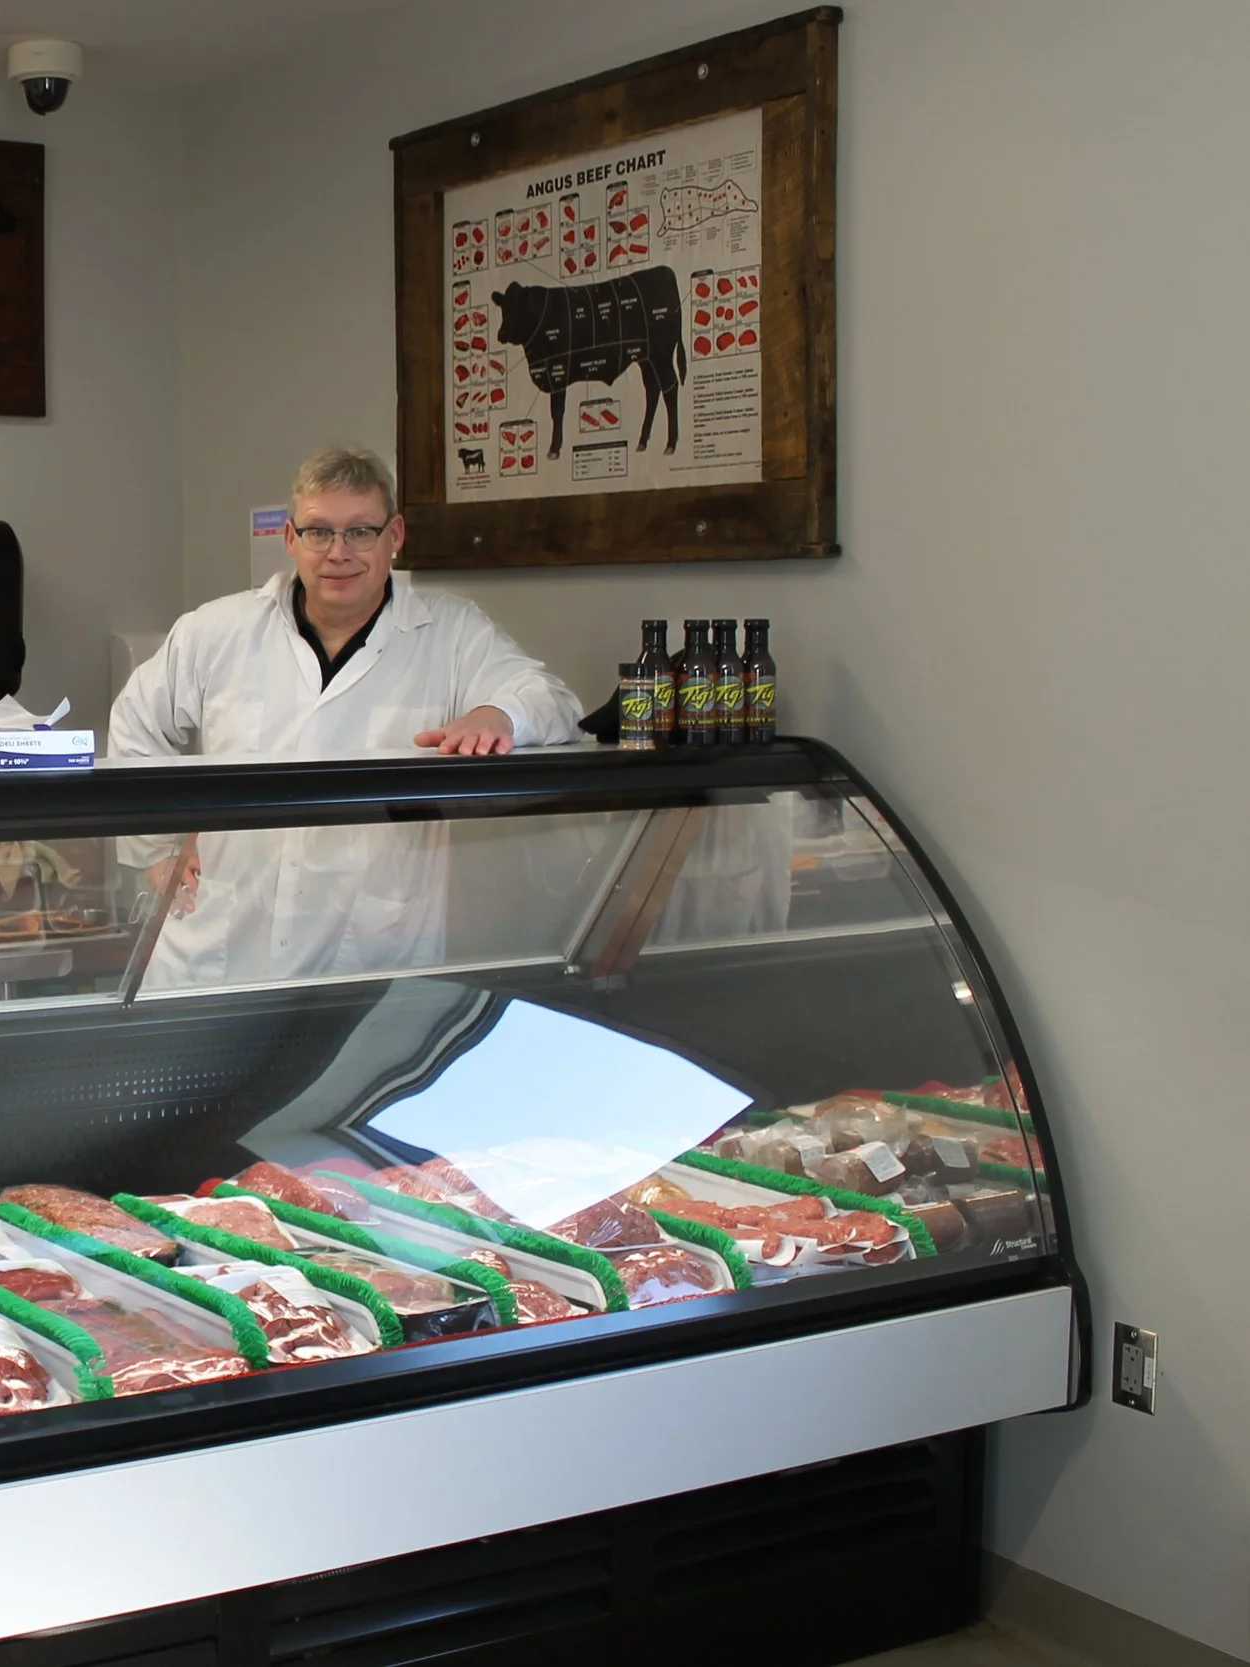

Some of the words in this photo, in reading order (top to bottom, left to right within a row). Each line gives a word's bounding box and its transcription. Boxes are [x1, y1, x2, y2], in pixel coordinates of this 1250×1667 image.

[526, 174, 573, 199] ANGUS
[576, 164, 612, 186] BEEF
[615, 150, 666, 175] CHART
